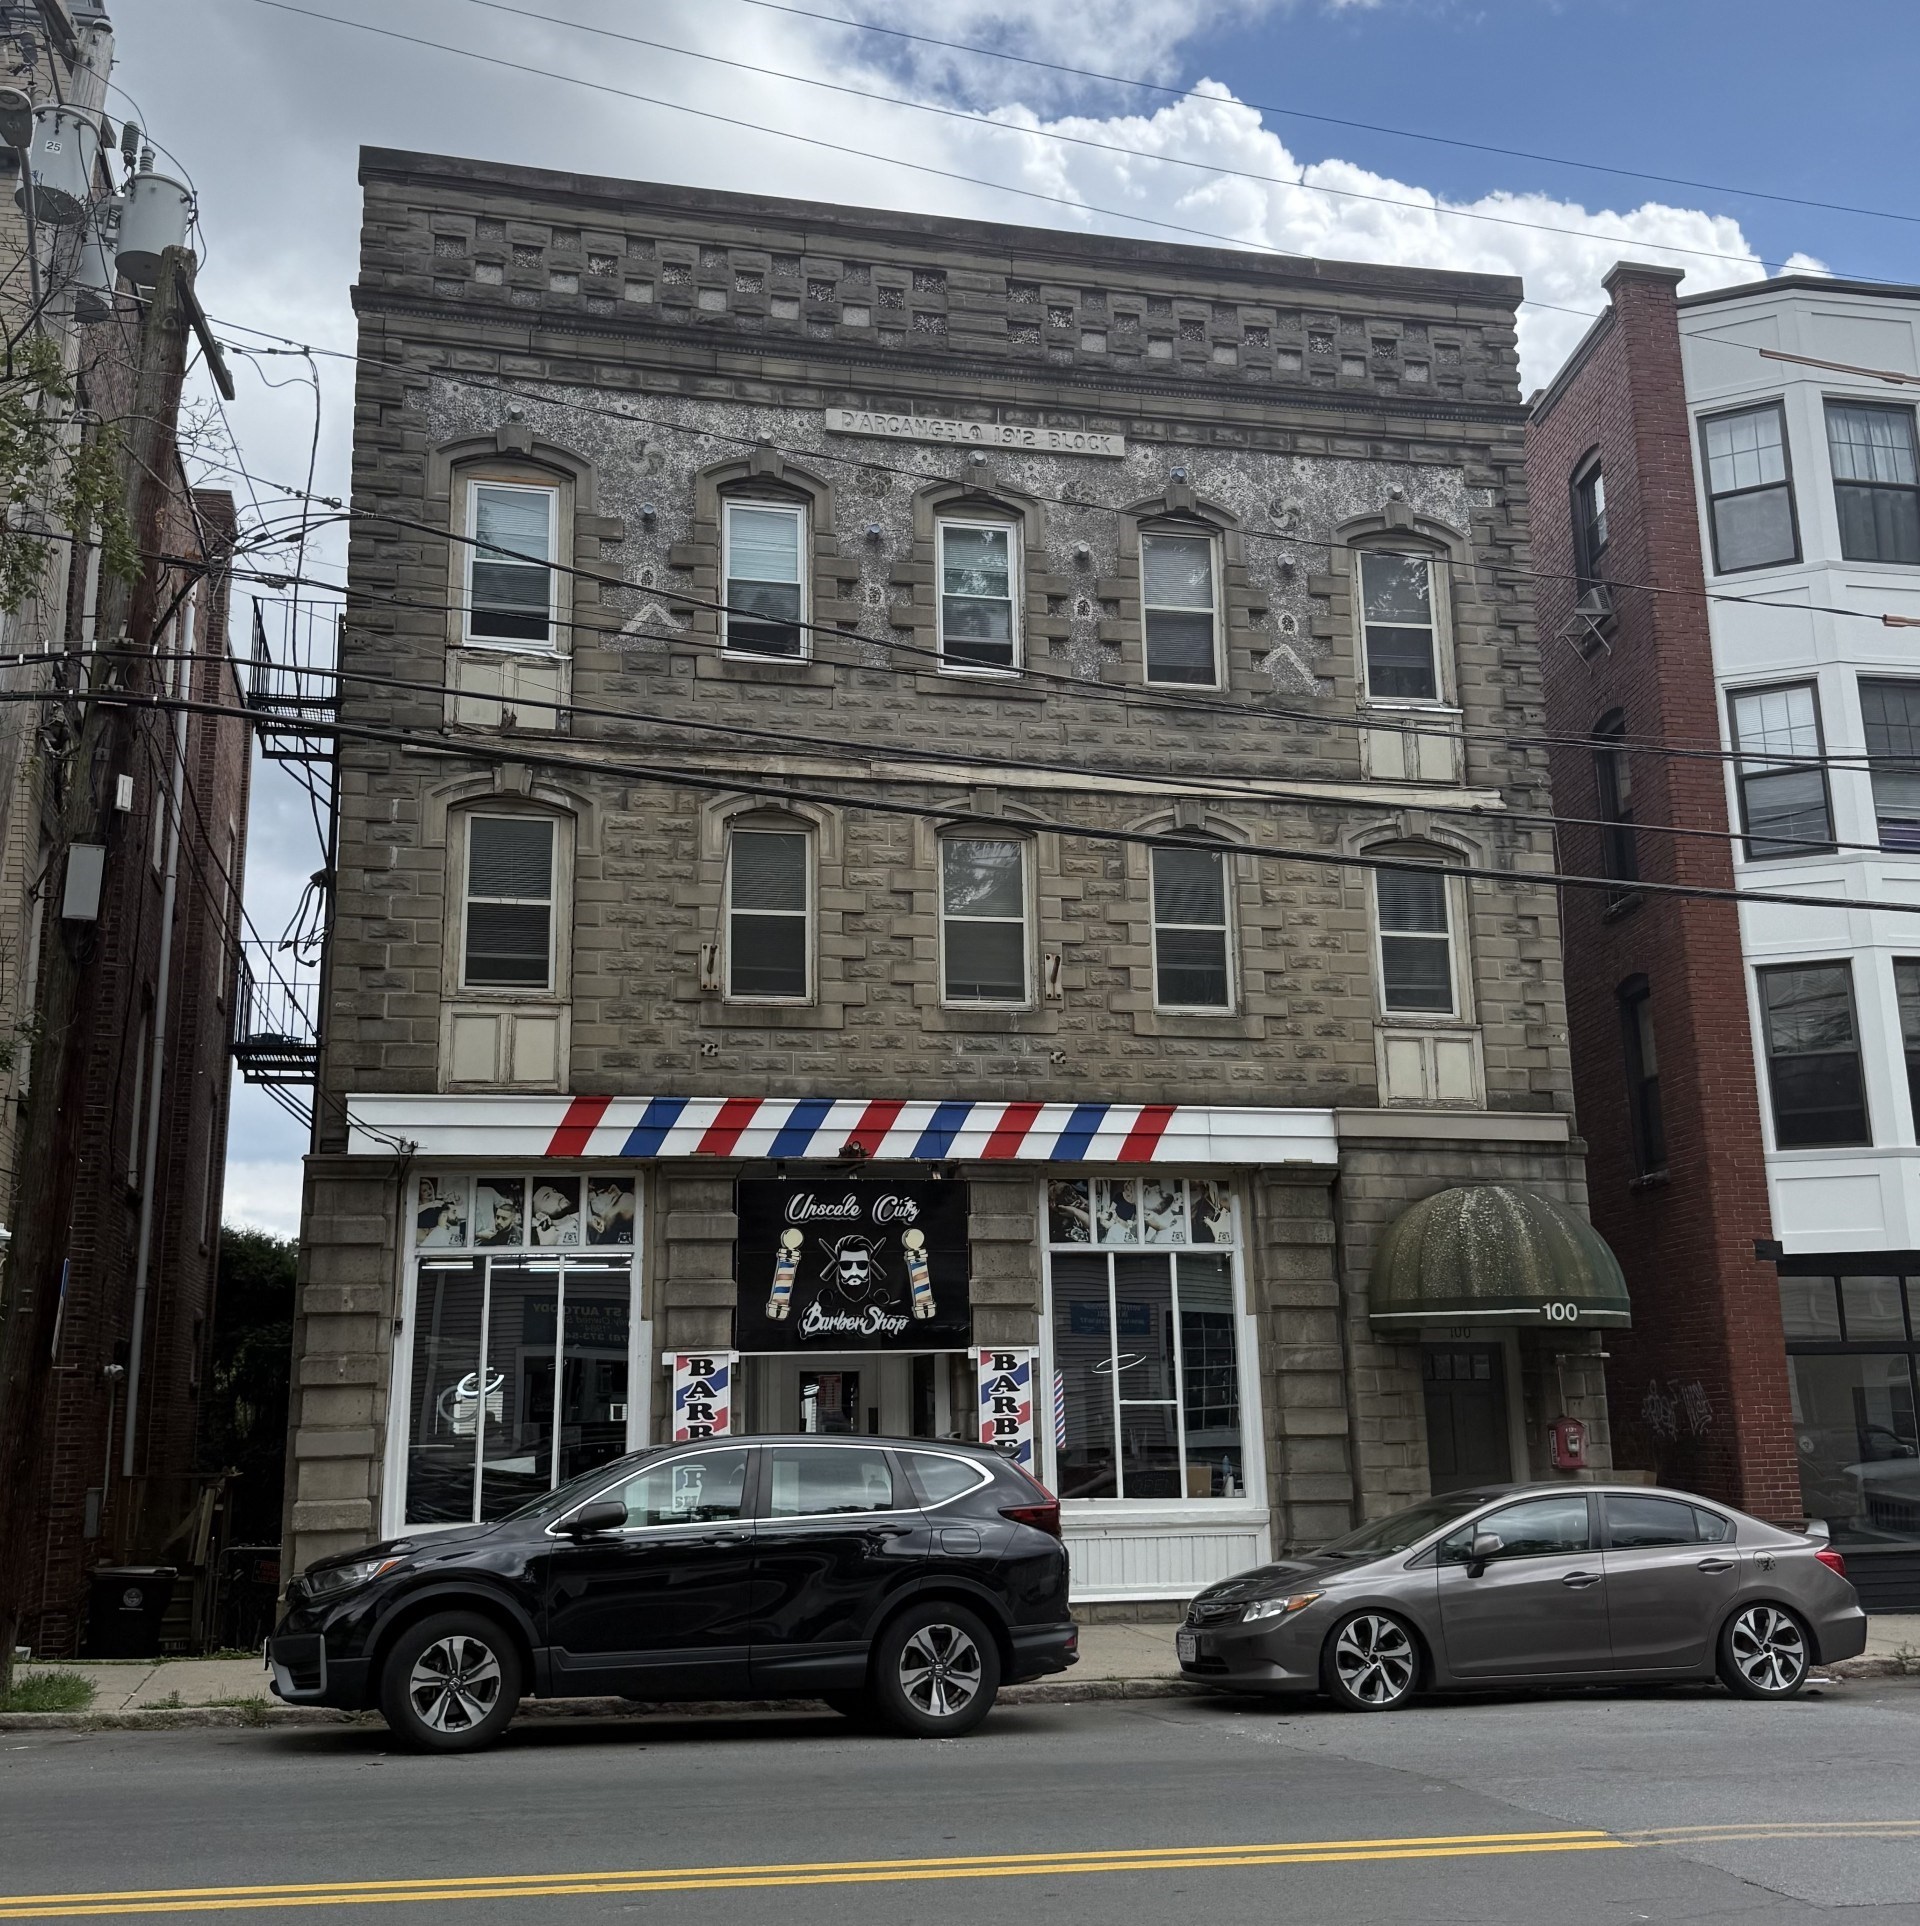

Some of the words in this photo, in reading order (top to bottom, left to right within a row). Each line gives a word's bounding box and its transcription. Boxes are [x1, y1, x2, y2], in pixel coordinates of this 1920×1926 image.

[46, 141, 61, 151] 25
[994, 426, 1036, 447] 1912
[1047, 431, 1112, 454] BLOCK
[1542, 1302, 1578, 1321] 100
